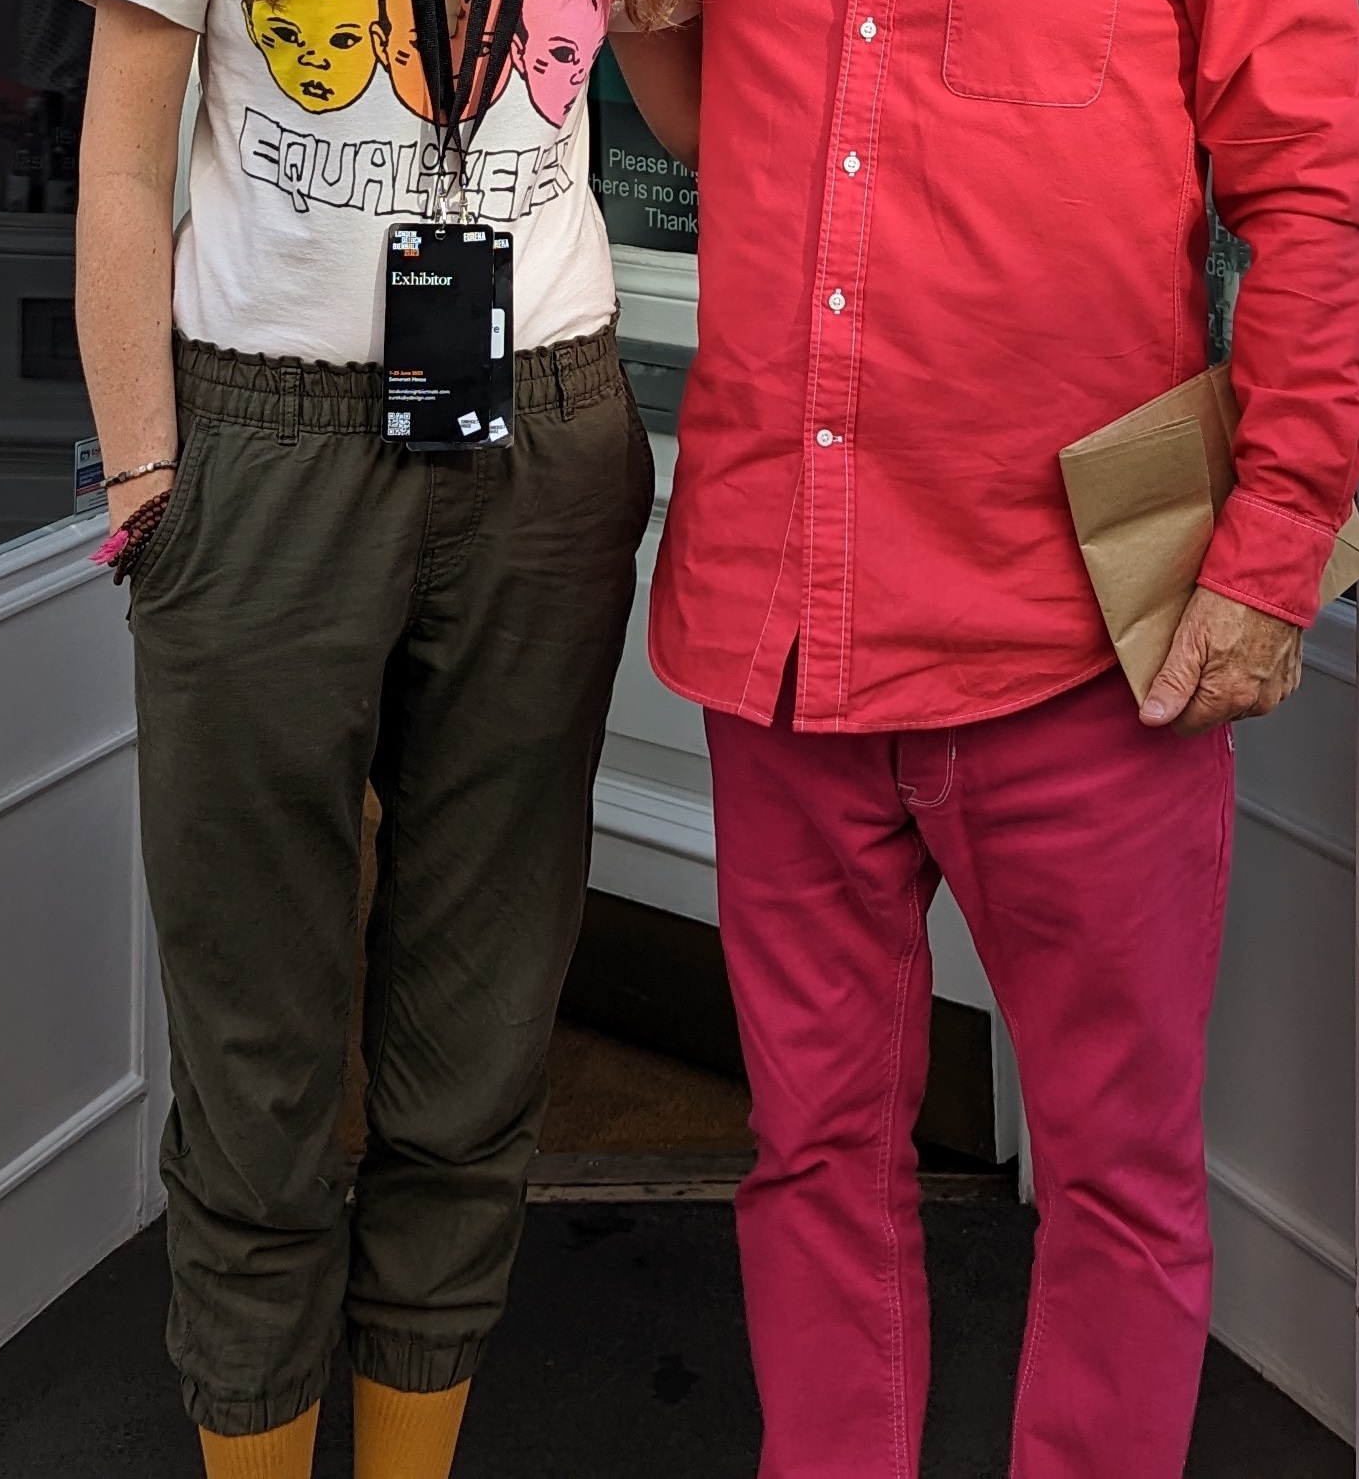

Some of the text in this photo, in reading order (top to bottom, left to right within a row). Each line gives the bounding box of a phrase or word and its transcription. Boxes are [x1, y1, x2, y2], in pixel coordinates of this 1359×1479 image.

[609, 148, 699, 183] Please ri
[590, 172, 630, 197] here
[634, 178, 648, 199] is
[652, 185, 674, 203] no
[645, 207, 699, 234] Thank
[391, 270, 453, 289] Exhibitor
